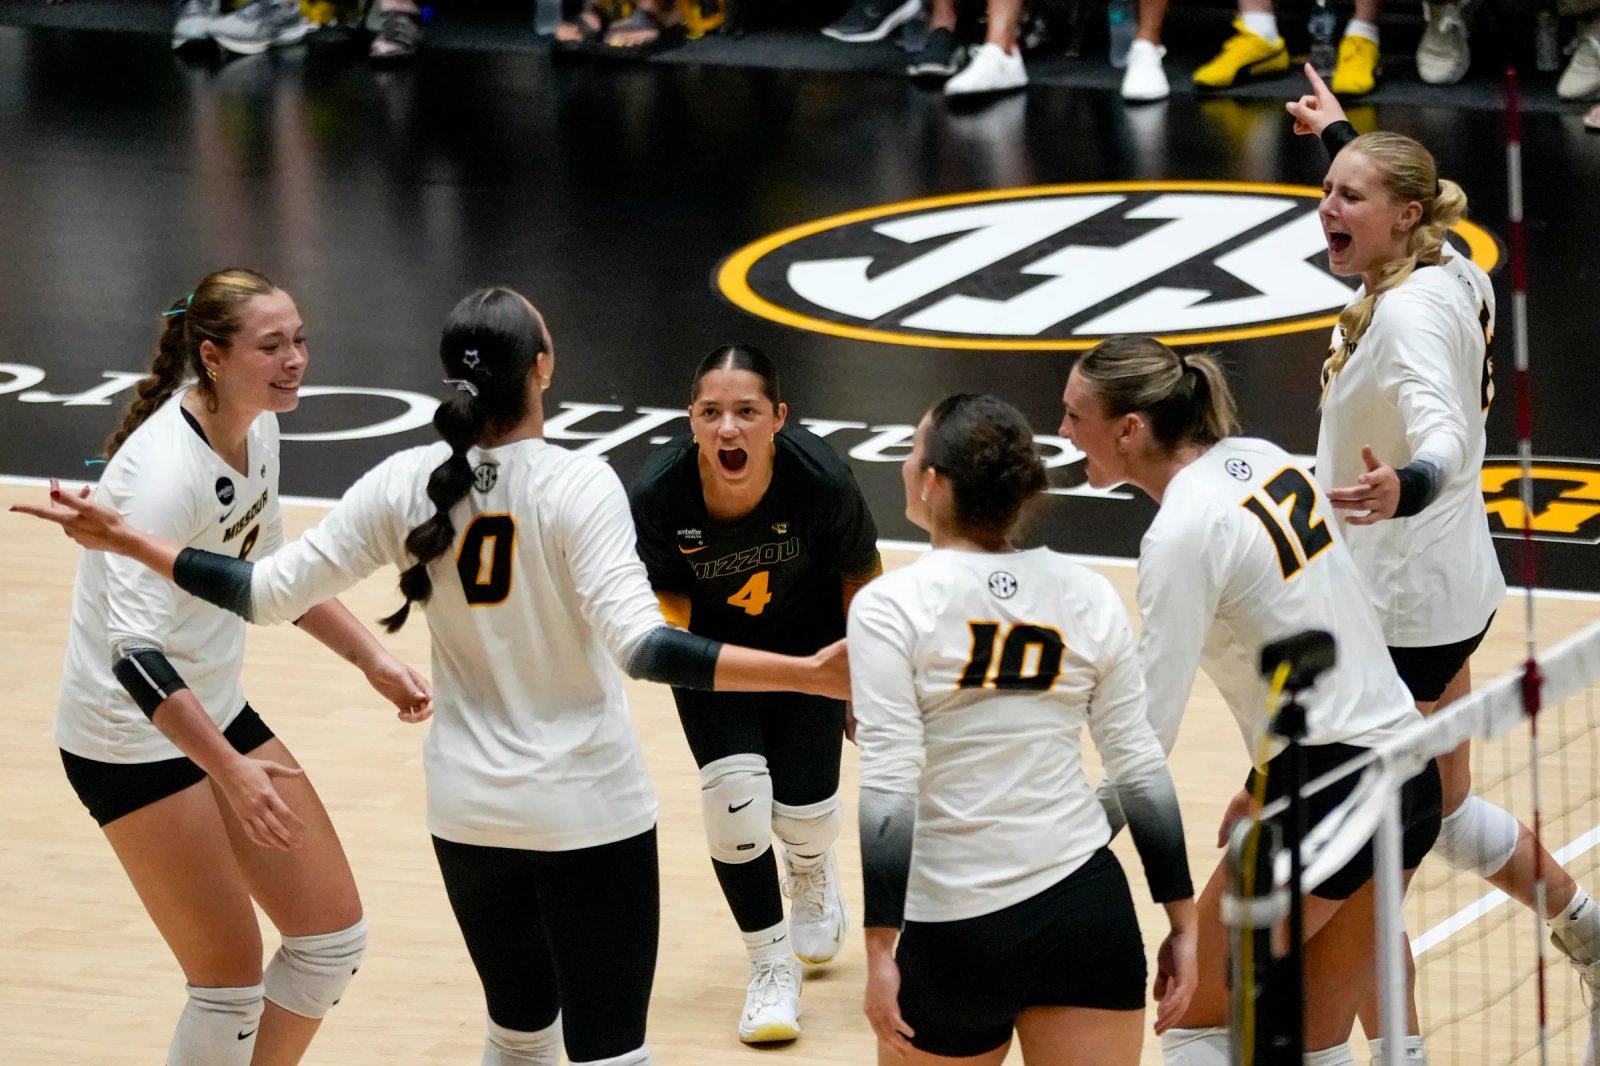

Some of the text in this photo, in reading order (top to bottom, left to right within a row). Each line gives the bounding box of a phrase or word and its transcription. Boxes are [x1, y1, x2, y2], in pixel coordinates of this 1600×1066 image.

[787, 193, 1357, 335] SEC
[474, 464, 498, 493] SEC
[222, 487, 268, 543] MISSOUR
[1239, 465, 1335, 582] 12
[455, 511, 520, 608] 0
[988, 571, 1018, 599] SEC
[726, 570, 772, 617] 4
[955, 617, 1067, 692] 10
